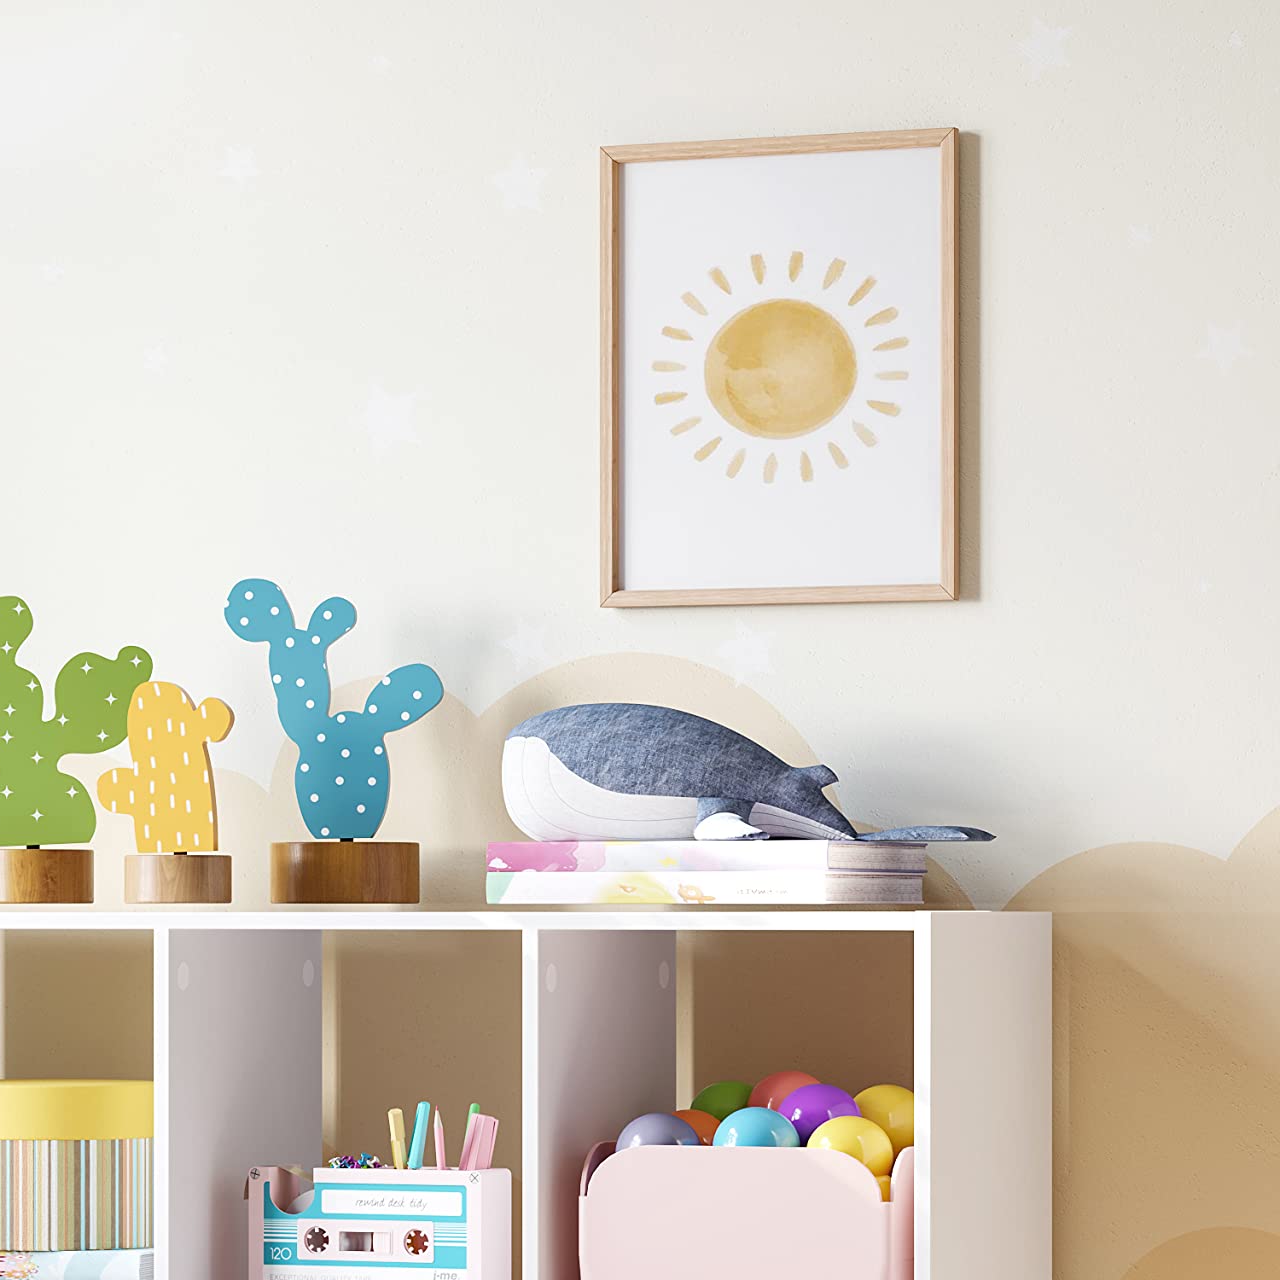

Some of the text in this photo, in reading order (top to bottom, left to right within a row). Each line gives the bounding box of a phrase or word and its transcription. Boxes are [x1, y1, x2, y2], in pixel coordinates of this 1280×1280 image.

[355, 1197, 428, 1212] rewind desk tidy
[270, 1247, 292, 1260] 120
